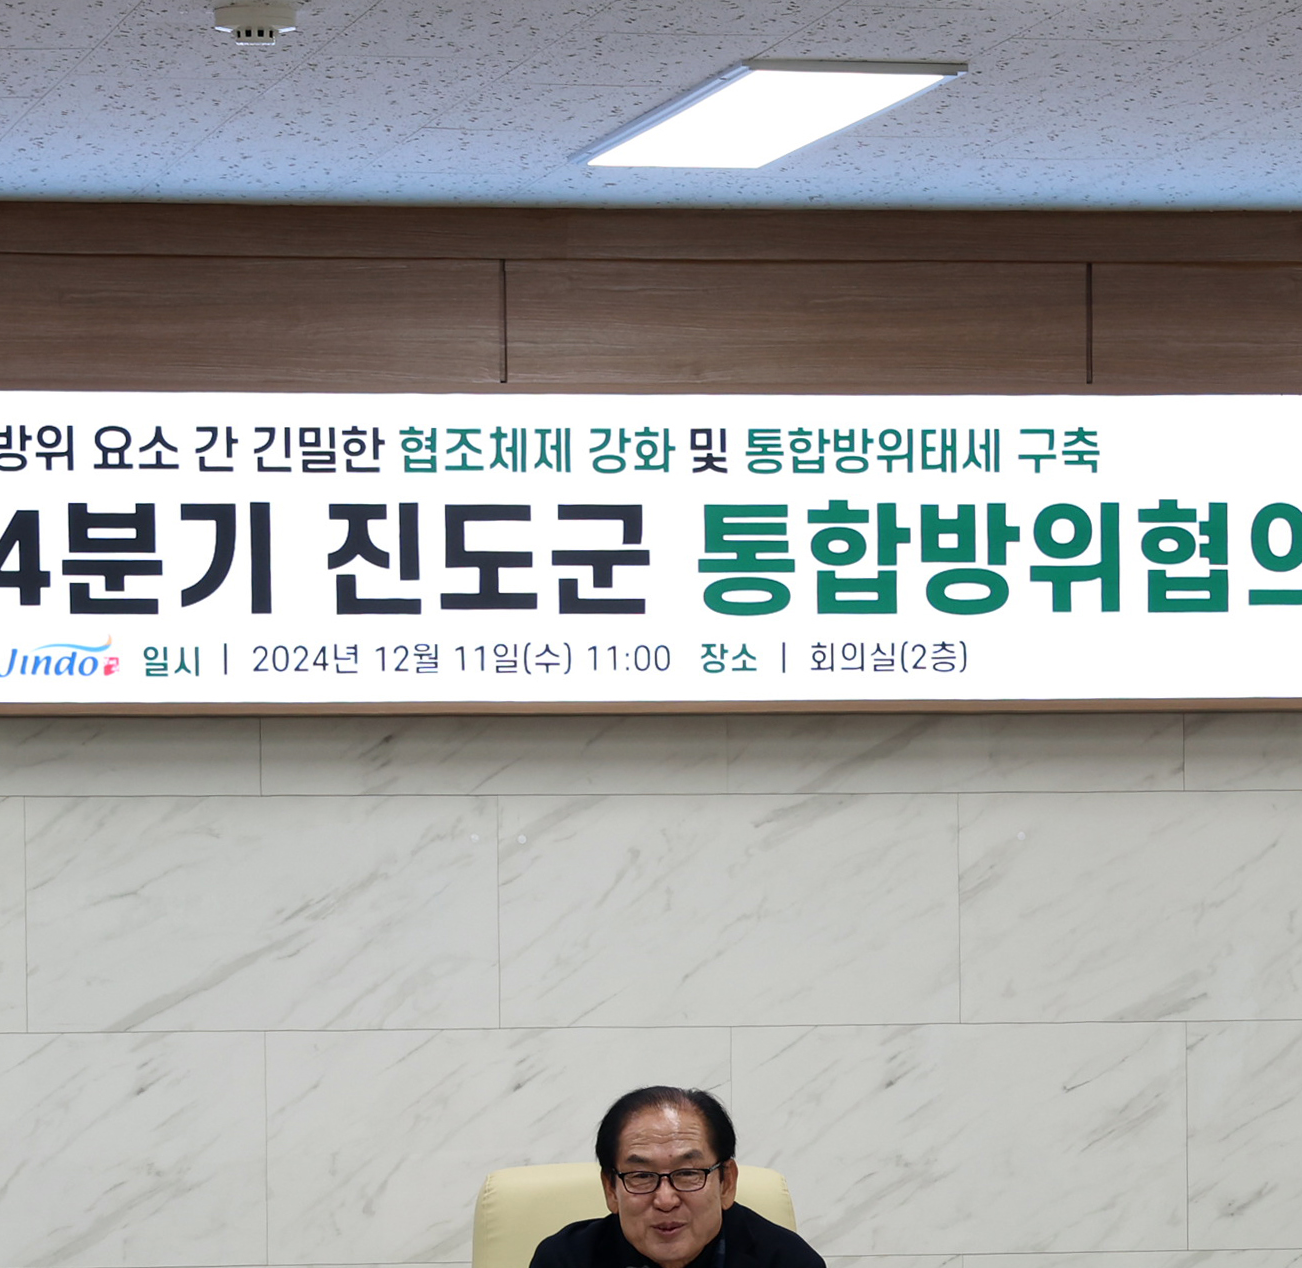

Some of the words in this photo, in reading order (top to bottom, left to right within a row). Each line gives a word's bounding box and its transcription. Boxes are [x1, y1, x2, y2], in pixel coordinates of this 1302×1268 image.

[93, 425, 181, 470] 요소
[194, 426, 240, 473] 간
[253, 425, 387, 474] 긴밀한
[398, 425, 573, 474] 협조체제
[589, 426, 678, 474] 강화
[689, 427, 729, 474] 및
[745, 426, 1002, 475] 통합방위태세
[1017, 426, 1102, 474] 구축
[326, 501, 652, 617] 진도군
[142, 645, 201, 678] 일시
[251, 643, 359, 675] 2024년
[374, 643, 440, 675] 12월
[454, 642, 573, 676] 11일(수)
[586, 643, 671, 673] 11:00
[699, 643, 759, 675] 장소
[809, 640, 968, 674] 회의실(2층)
